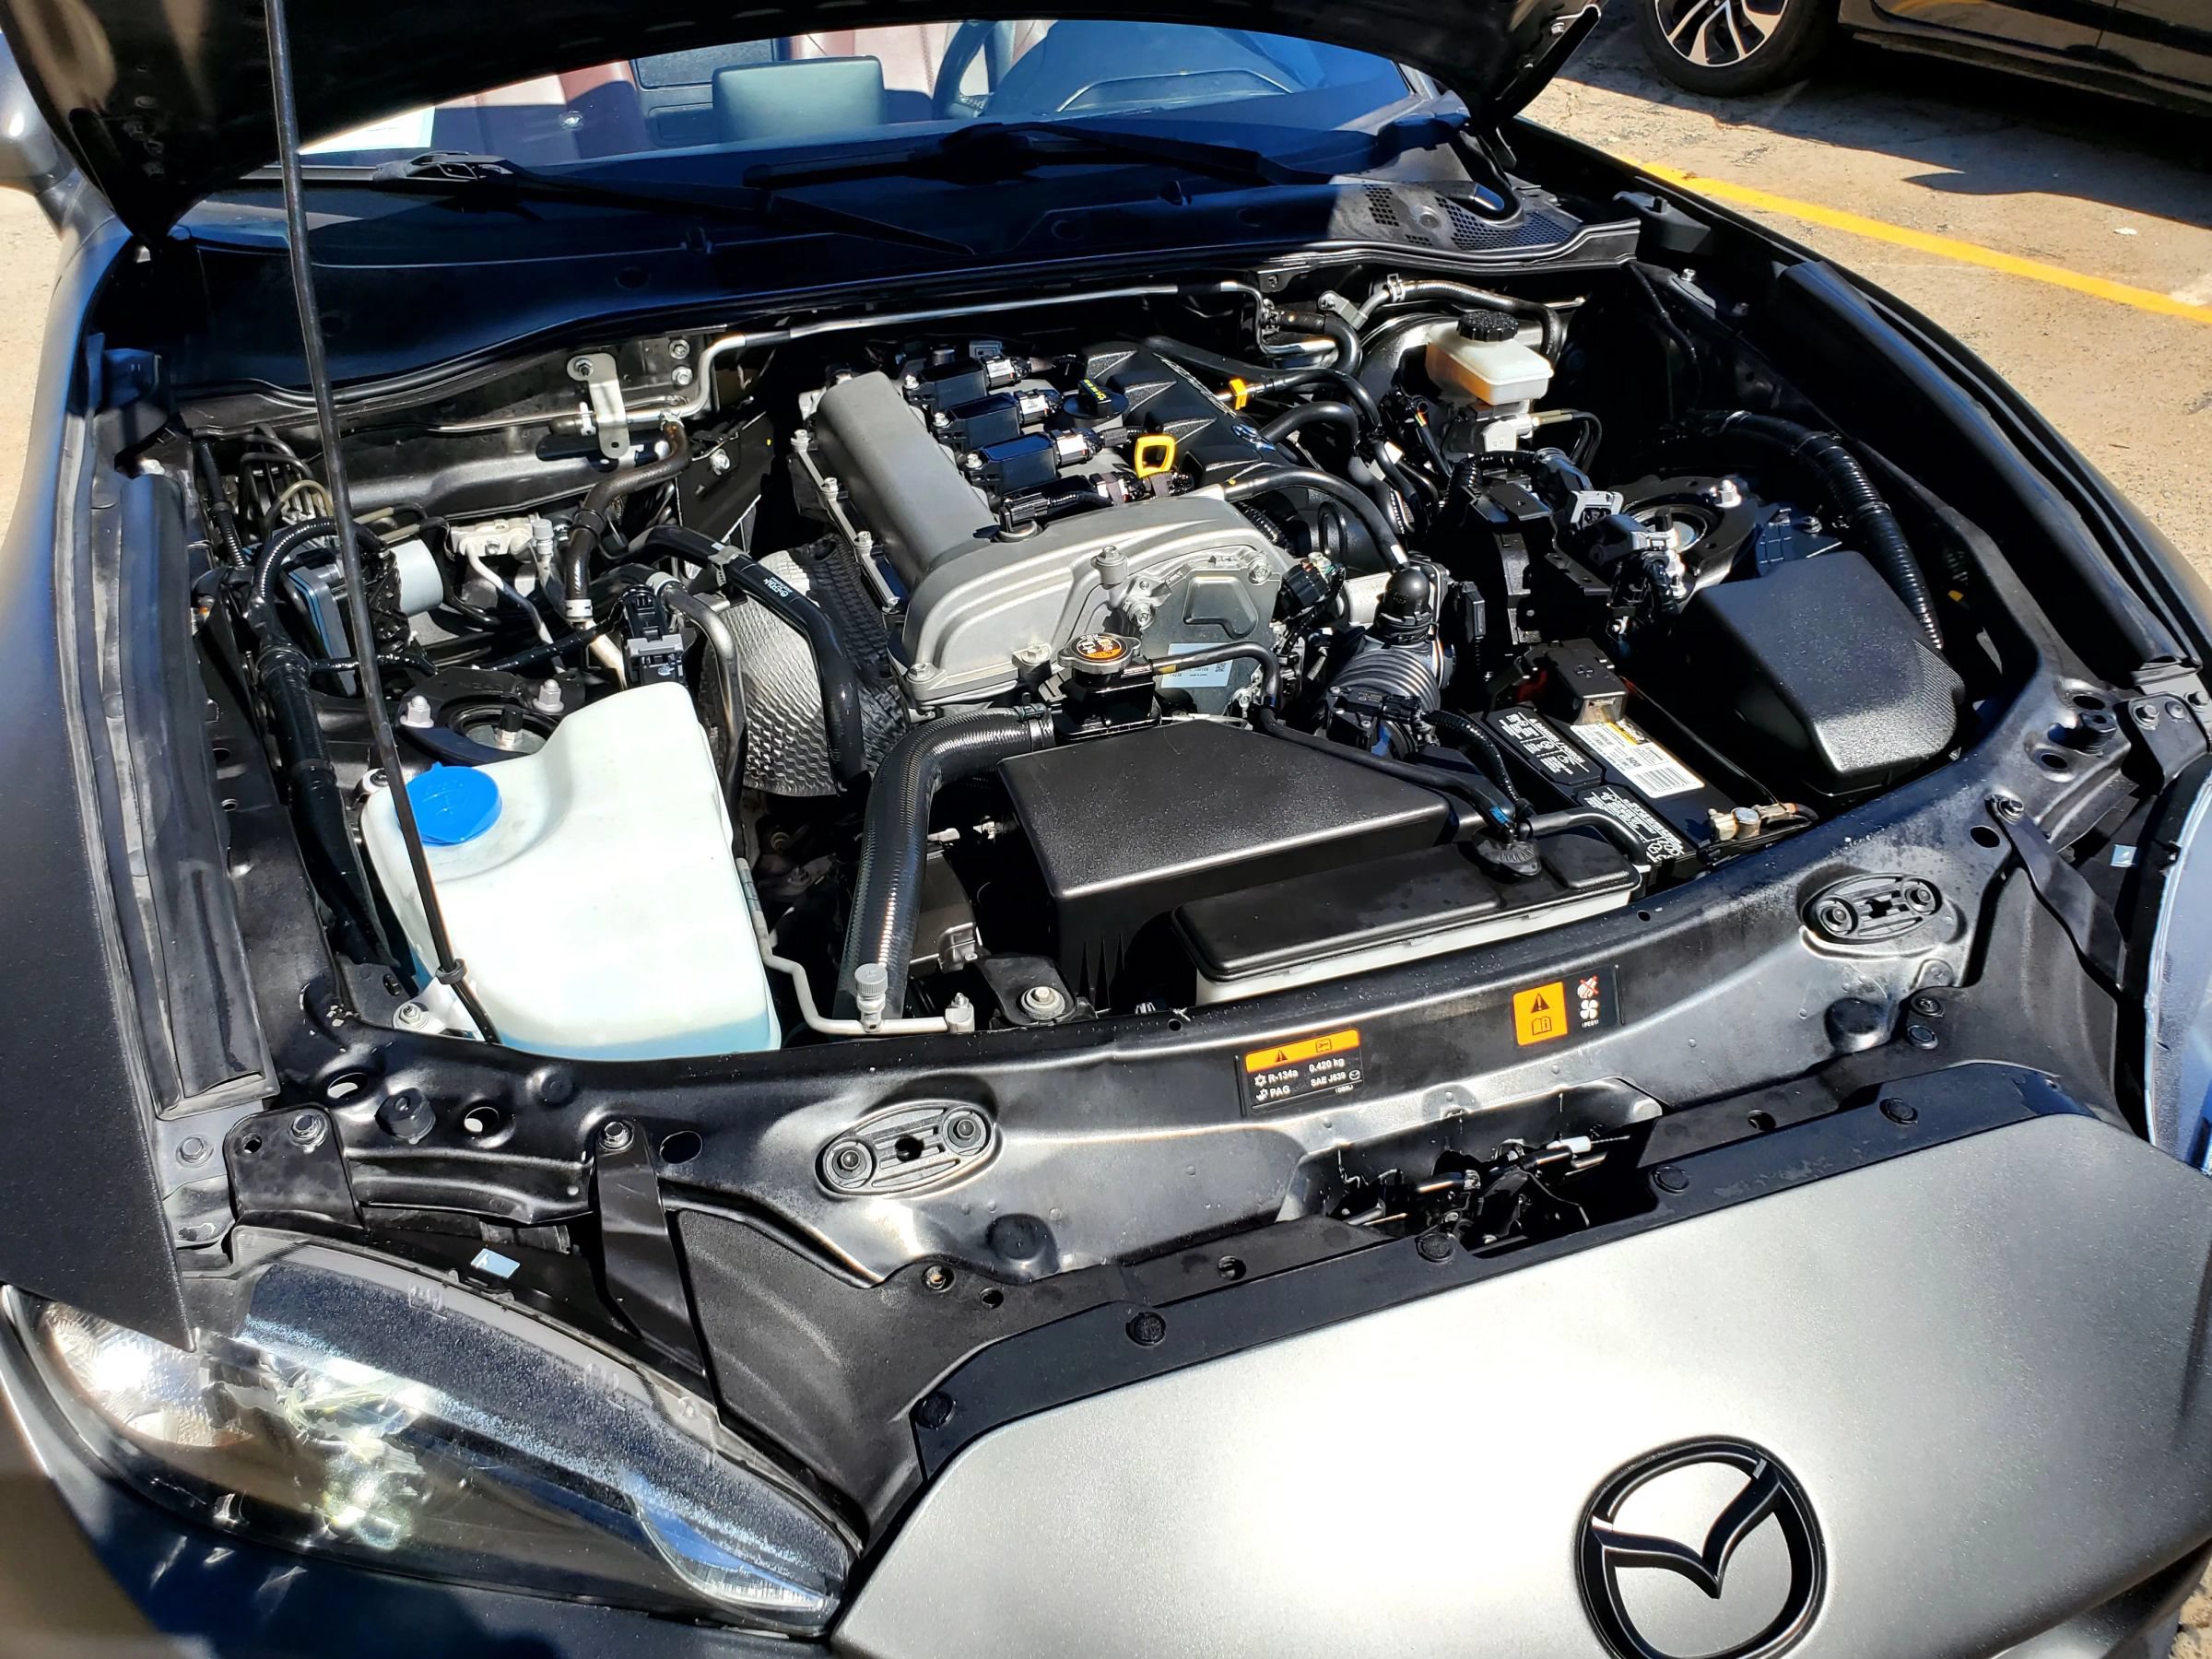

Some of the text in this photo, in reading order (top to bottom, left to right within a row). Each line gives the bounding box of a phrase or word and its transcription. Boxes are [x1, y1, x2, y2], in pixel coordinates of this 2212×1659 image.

[1267, 1058, 1346, 1084] R-134a 0.420 kg
[1269, 1085, 1291, 1098] PAG
[1310, 1077, 1327, 1088] SAE
